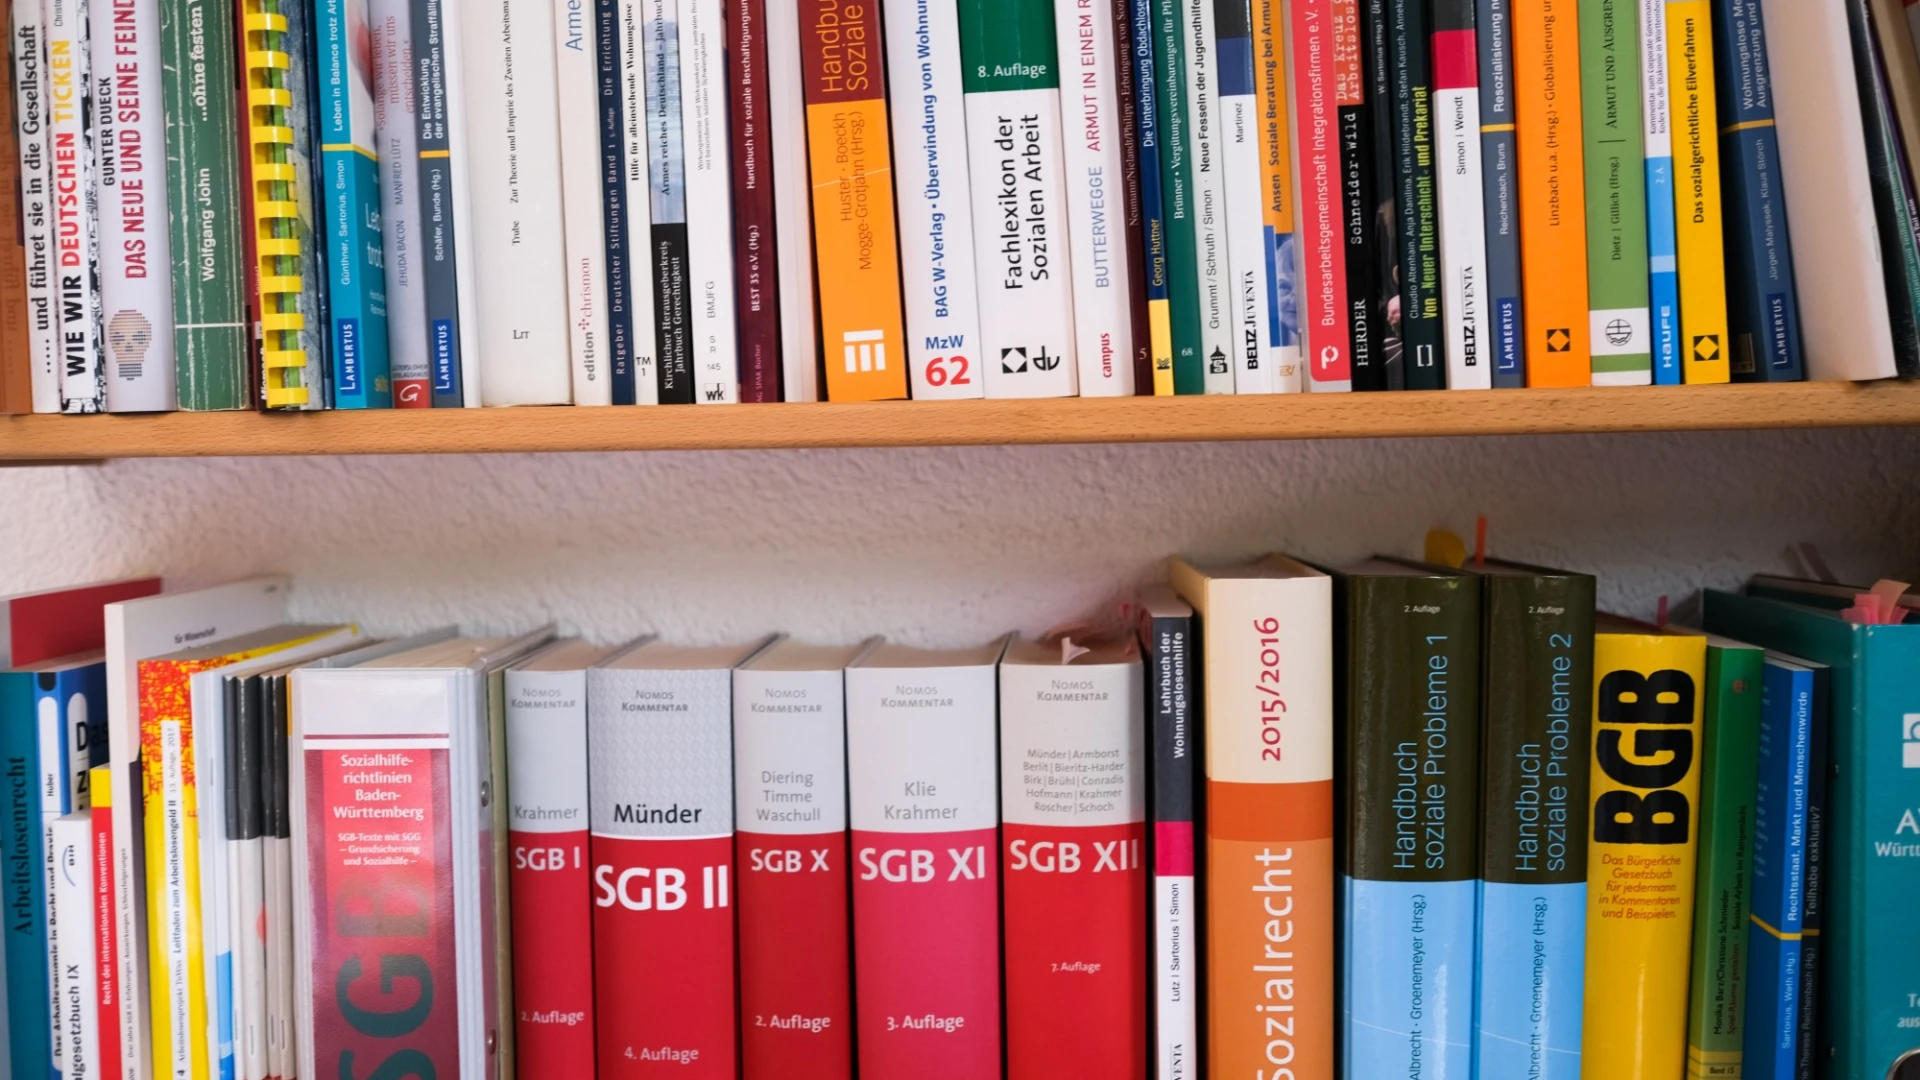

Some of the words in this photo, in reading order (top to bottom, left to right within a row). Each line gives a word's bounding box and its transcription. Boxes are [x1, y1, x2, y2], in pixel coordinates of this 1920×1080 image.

[328, 17, 338, 41] trotz
[1078, 14, 1095, 66] EINEM
[1163, 18, 1174, 33] für
[330, 44, 340, 85] Balance
[840, 5, 868, 91] Soziale
[1262, 38, 1274, 58] bei
[1491, 13, 1504, 112] Resozialisierung
[1684, 18, 1698, 91] Eilverfahren
[18, 25, 40, 135] Gesellschaft
[51, 40, 73, 123] TICKEN
[116, 62, 140, 122] SEINE
[332, 88, 341, 97] in
[420, 58, 432, 120] Entwicklung
[430, 46, 444, 121] evangelischen
[656, 53, 666, 117] Deutschland
[922, 62, 932, 91] von
[977, 65, 989, 78] 8.
[994, 62, 1046, 79] Auflage
[1082, 72, 1096, 89] IN
[1195, 71, 1206, 91] der
[1265, 60, 1278, 119] Beratung
[98, 77, 112, 125] DUECK
[1140, 59, 1154, 128] Unterbringung
[1166, 35, 1183, 169] Vergütungsvereinbarungen
[1308, 36, 1328, 151] Integrationsfirmen
[1411, 86, 1429, 142] Prekariat
[333, 100, 343, 132] Leben
[422, 122, 432, 140] Die
[434, 122, 443, 139] der
[832, 112, 849, 164] Boeckh
[848, 111, 866, 155] (Hrsg.)
[994, 116, 1014, 151] der
[1083, 94, 1101, 152] ARMUT
[1196, 93, 1208, 140] Fesseln
[1344, 112, 1357, 150] Wild
[23, 143, 41, 170] die
[100, 128, 115, 186] GUNTER
[119, 130, 142, 172] UND
[659, 121, 668, 159] reiches
[922, 94, 940, 200] Überwindung
[1020, 114, 1042, 182] Arbeit
[1143, 131, 1154, 147] Die
[1200, 142, 1210, 172] Neue
[1266, 122, 1280, 166] Soziale
[1414, 145, 1430, 166] und
[1687, 94, 1704, 198] sozialgerichtliche
[26, 178, 42, 194] in
[198, 168, 211, 206] John
[336, 160, 346, 189] Simon
[660, 162, 670, 196] Armes
[1272, 174, 1283, 213] Ansen
[27, 202, 44, 226] sie
[55, 133, 80, 266] DEUTSCHEN
[121, 179, 145, 232] NEUE
[338, 192, 348, 237] Sartorius,
[838, 176, 852, 222] Huster
[852, 158, 874, 270] Mogge-Grotjahn
[1174, 178, 1184, 219] Brünner
[1203, 189, 1214, 225] Simon
[1348, 160, 1362, 244] Schneider
[1693, 201, 1704, 224] Das
[201, 208, 216, 282] Wolfgang
[998, 159, 1023, 289] Fachlexikon
[1025, 190, 1049, 281] Sozialen
[1088, 166, 1110, 288] BUTTERWEGGE
[1150, 219, 1161, 254] Huttner
[1312, 154, 1335, 326] Bundesarbeitsgemeinschaft
[29, 234, 47, 289] führet
[124, 239, 147, 278] DAS
[340, 239, 350, 285] Günthner,
[929, 212, 946, 282] W-Verlag
[1204, 233, 1217, 276] Schruth
[580, 258, 592, 318] chrismon
[659, 241, 671, 330] Herausgeberkreis
[671, 257, 682, 325] Gerechtigkeit
[1152, 257, 1164, 286] Georg
[30, 297, 49, 330] und
[62, 275, 83, 323] WIR
[934, 286, 948, 318] BAG
[1208, 284, 1220, 330] Grummt
[1244, 271, 1256, 328] JUVENTA
[1422, 298, 1437, 318] Von
[1462, 266, 1475, 324] JUVENTA
[65, 332, 86, 377] WIE
[673, 327, 686, 373] Jahrbuch
[926, 334, 964, 350] MzW
[1245, 329, 1258, 370] BELTZ
[1354, 299, 1368, 366] HERDER
[1464, 325, 1476, 366] BELTZ
[583, 332, 596, 381] edition
[663, 332, 674, 389] Kirchlicher
[925, 356, 970, 387] 62
[1100, 333, 1114, 378] campus
[1160, 632, 1170, 653] der
[1426, 636, 1448, 645] 1
[1549, 634, 1572, 648] 2
[1160, 656, 1171, 714] Lehrbuch
[1172, 632, 1186, 758] Wohnungslosenhilfe
[1254, 617, 1287, 761] 2015/2016
[1422, 655, 1448, 775] Probleme
[1546, 656, 1571, 776] Probleme
[341, 754, 414, 767] Sozialhilfe-
[1593, 669, 1696, 845] BGB
[1793, 692, 1808, 785] Menschenwürde
[343, 771, 412, 784] richtlinien
[355, 788, 401, 801] Baden-
[761, 770, 814, 788] Diering
[762, 789, 812, 803] Timme
[904, 781, 936, 796] Klie
[1793, 789, 1803, 810] und
[333, 805, 425, 822] Württemberg
[514, 805, 579, 821] Krahmer
[614, 803, 702, 824] Münder
[756, 808, 820, 822] Waschull
[884, 804, 958, 820] Krahmer
[1392, 742, 1418, 868] Handbuch
[1421, 784, 1446, 869] soziale
[1514, 744, 1541, 870] Handbuch
[5, 757, 32, 935] Arbeitslosenrecht
[1544, 786, 1568, 871] soziale
[1790, 814, 1802, 846] Markt
[98, 832, 108, 893] Konventionen
[517, 847, 565, 871] SGB
[574, 847, 580, 868] I
[751, 848, 802, 873] SGB
[810, 849, 829, 872] X
[860, 848, 935, 882] SGB
[948, 846, 985, 882] XI
[1010, 839, 1081, 873] SGB
[1093, 840, 1136, 872] XII
[595, 865, 687, 911] SGB
[703, 865, 728, 909] II
[1787, 853, 1800, 921] Rechtsstaat,
[100, 894, 110, 962] internationalen
[102, 964, 111, 979] der
[1051, 963, 1059, 972] 7.
[1060, 961, 1101, 974] Auflage
[102, 980, 112, 1005] Recht
[755, 1015, 767, 1027] 2.
[770, 1014, 831, 1033] Auflage
[887, 1016, 899, 1031] 3.
[902, 1014, 964, 1033] Auflage
[624, 1046, 637, 1060] 4.
[640, 1046, 699, 1065] Auflage
